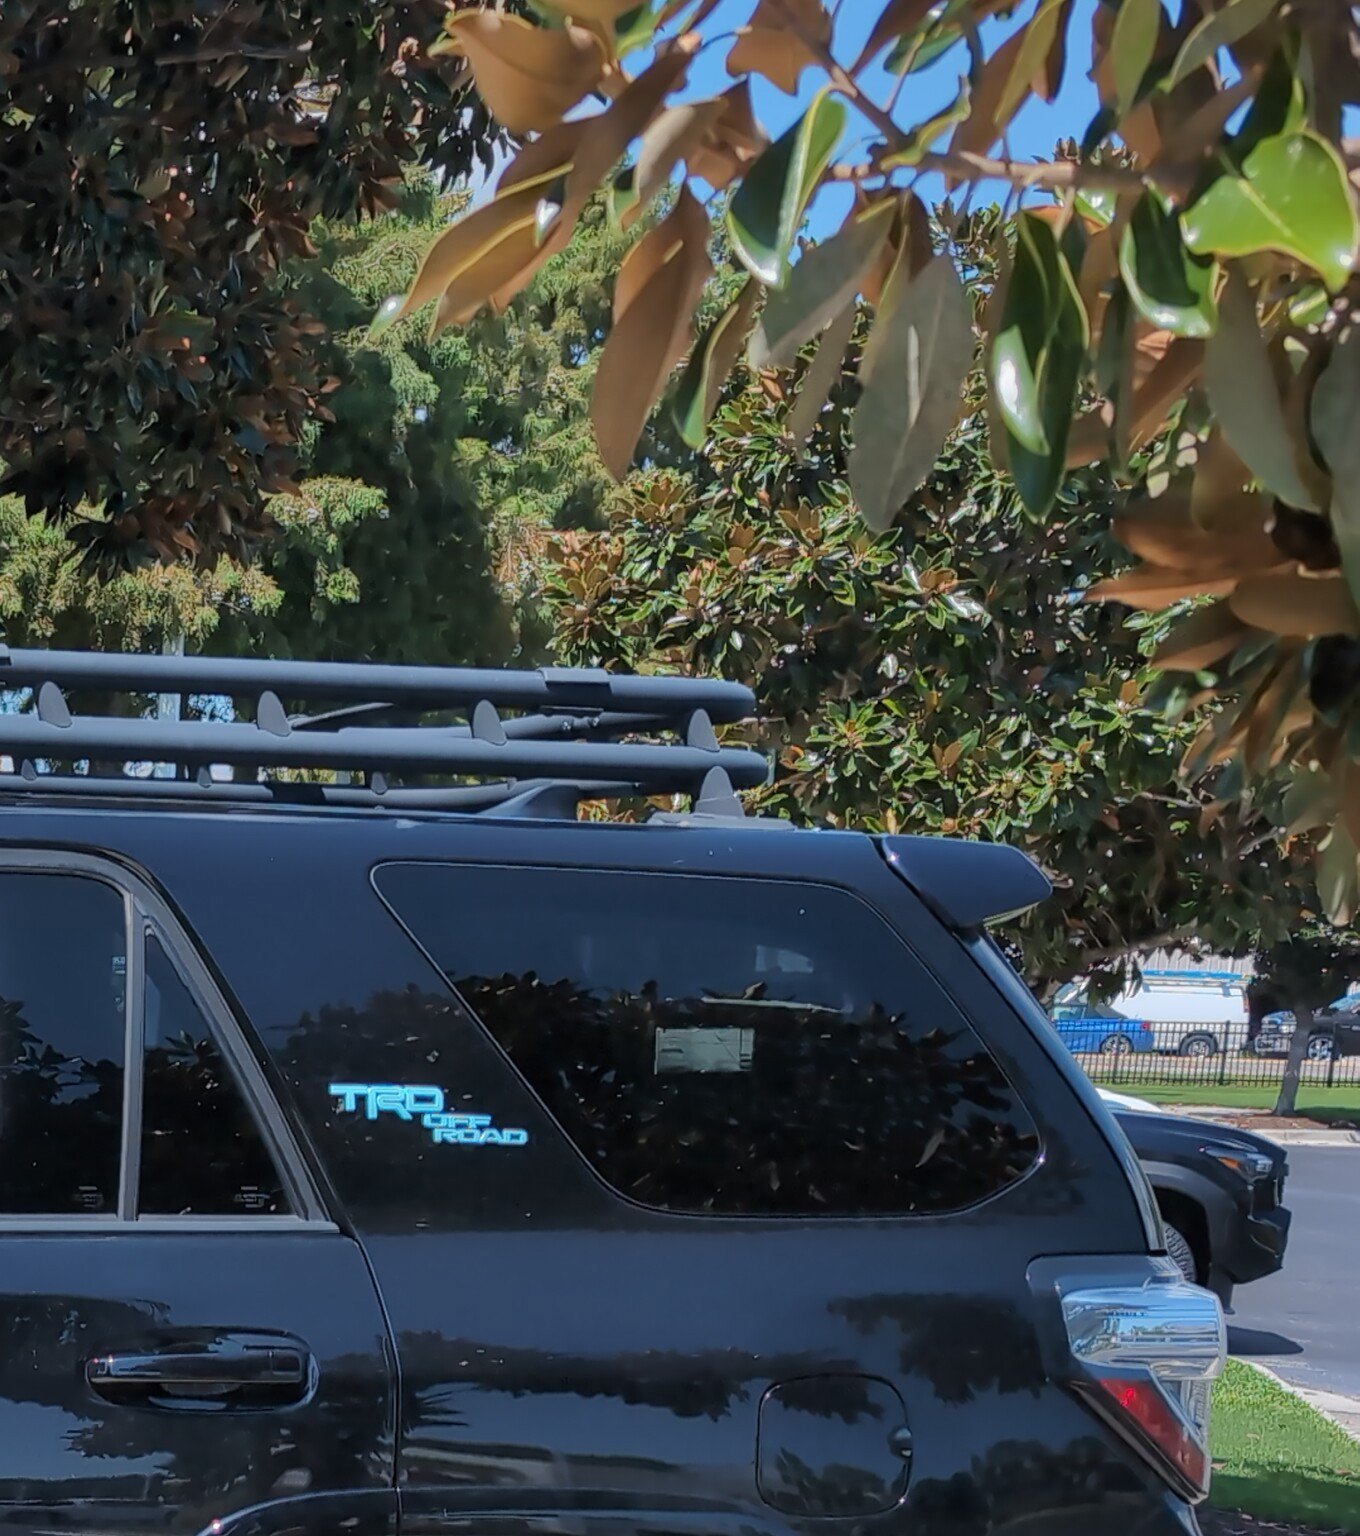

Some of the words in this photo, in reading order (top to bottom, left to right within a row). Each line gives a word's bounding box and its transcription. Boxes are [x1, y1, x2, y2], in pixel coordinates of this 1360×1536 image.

[329, 1083, 445, 1120] TRD
[423, 1113, 492, 1128] OFF
[433, 1128, 529, 1145] ROAD
